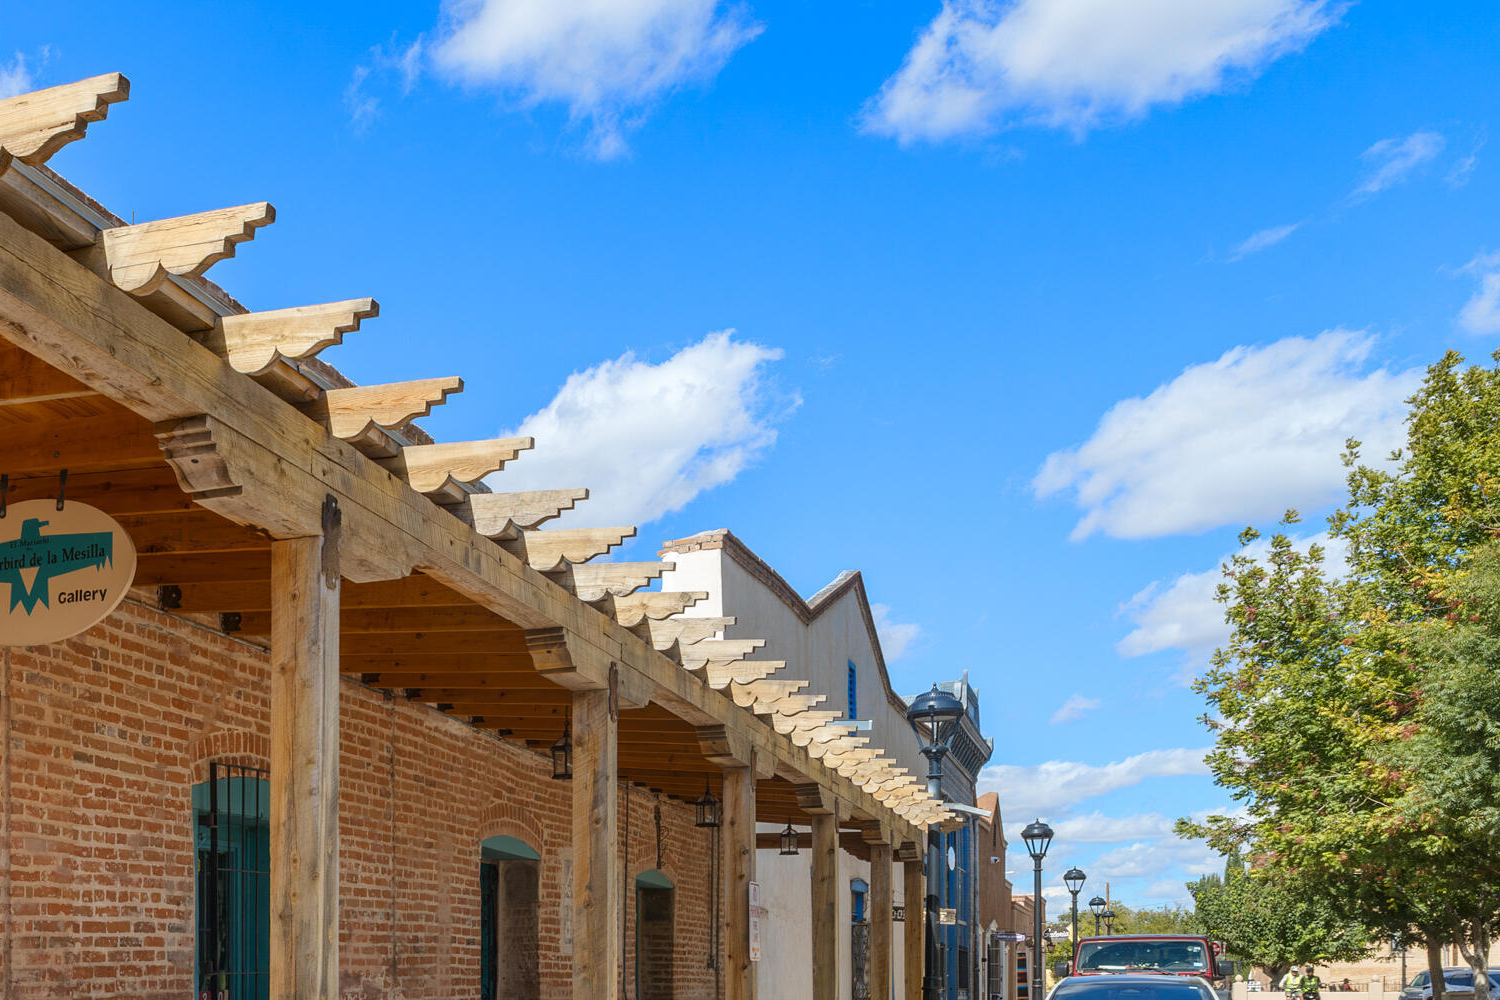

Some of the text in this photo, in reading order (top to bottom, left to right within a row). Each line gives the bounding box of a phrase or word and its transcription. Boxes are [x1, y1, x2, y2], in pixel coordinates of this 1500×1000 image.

[29, 552, 43, 567] de
[47, 550, 57, 564] la
[62, 543, 105, 562] Mesilla
[58, 588, 107, 604] Gallery
